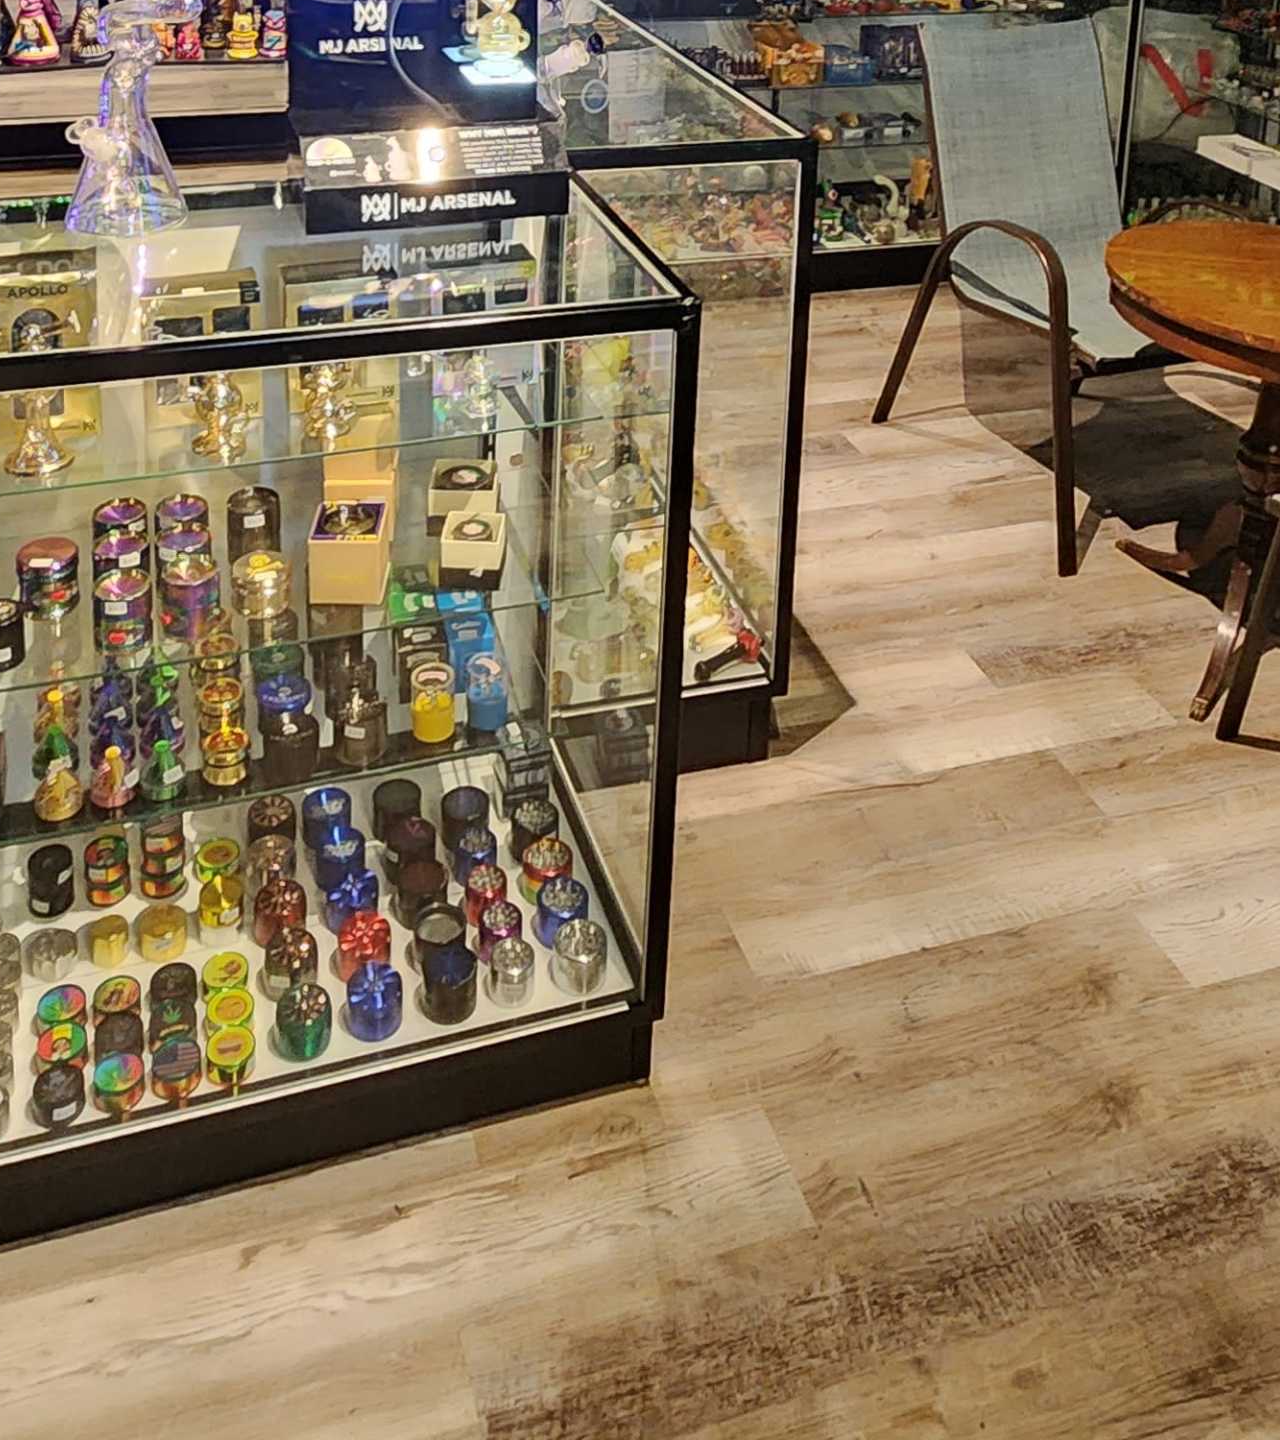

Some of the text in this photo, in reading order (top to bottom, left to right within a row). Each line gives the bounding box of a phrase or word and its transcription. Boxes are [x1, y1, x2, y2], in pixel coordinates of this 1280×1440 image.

[318, 38, 344, 55] MJ
[400, 190, 517, 215] MJ ARSENAL
[7, 283, 69, 300] APOLLO
